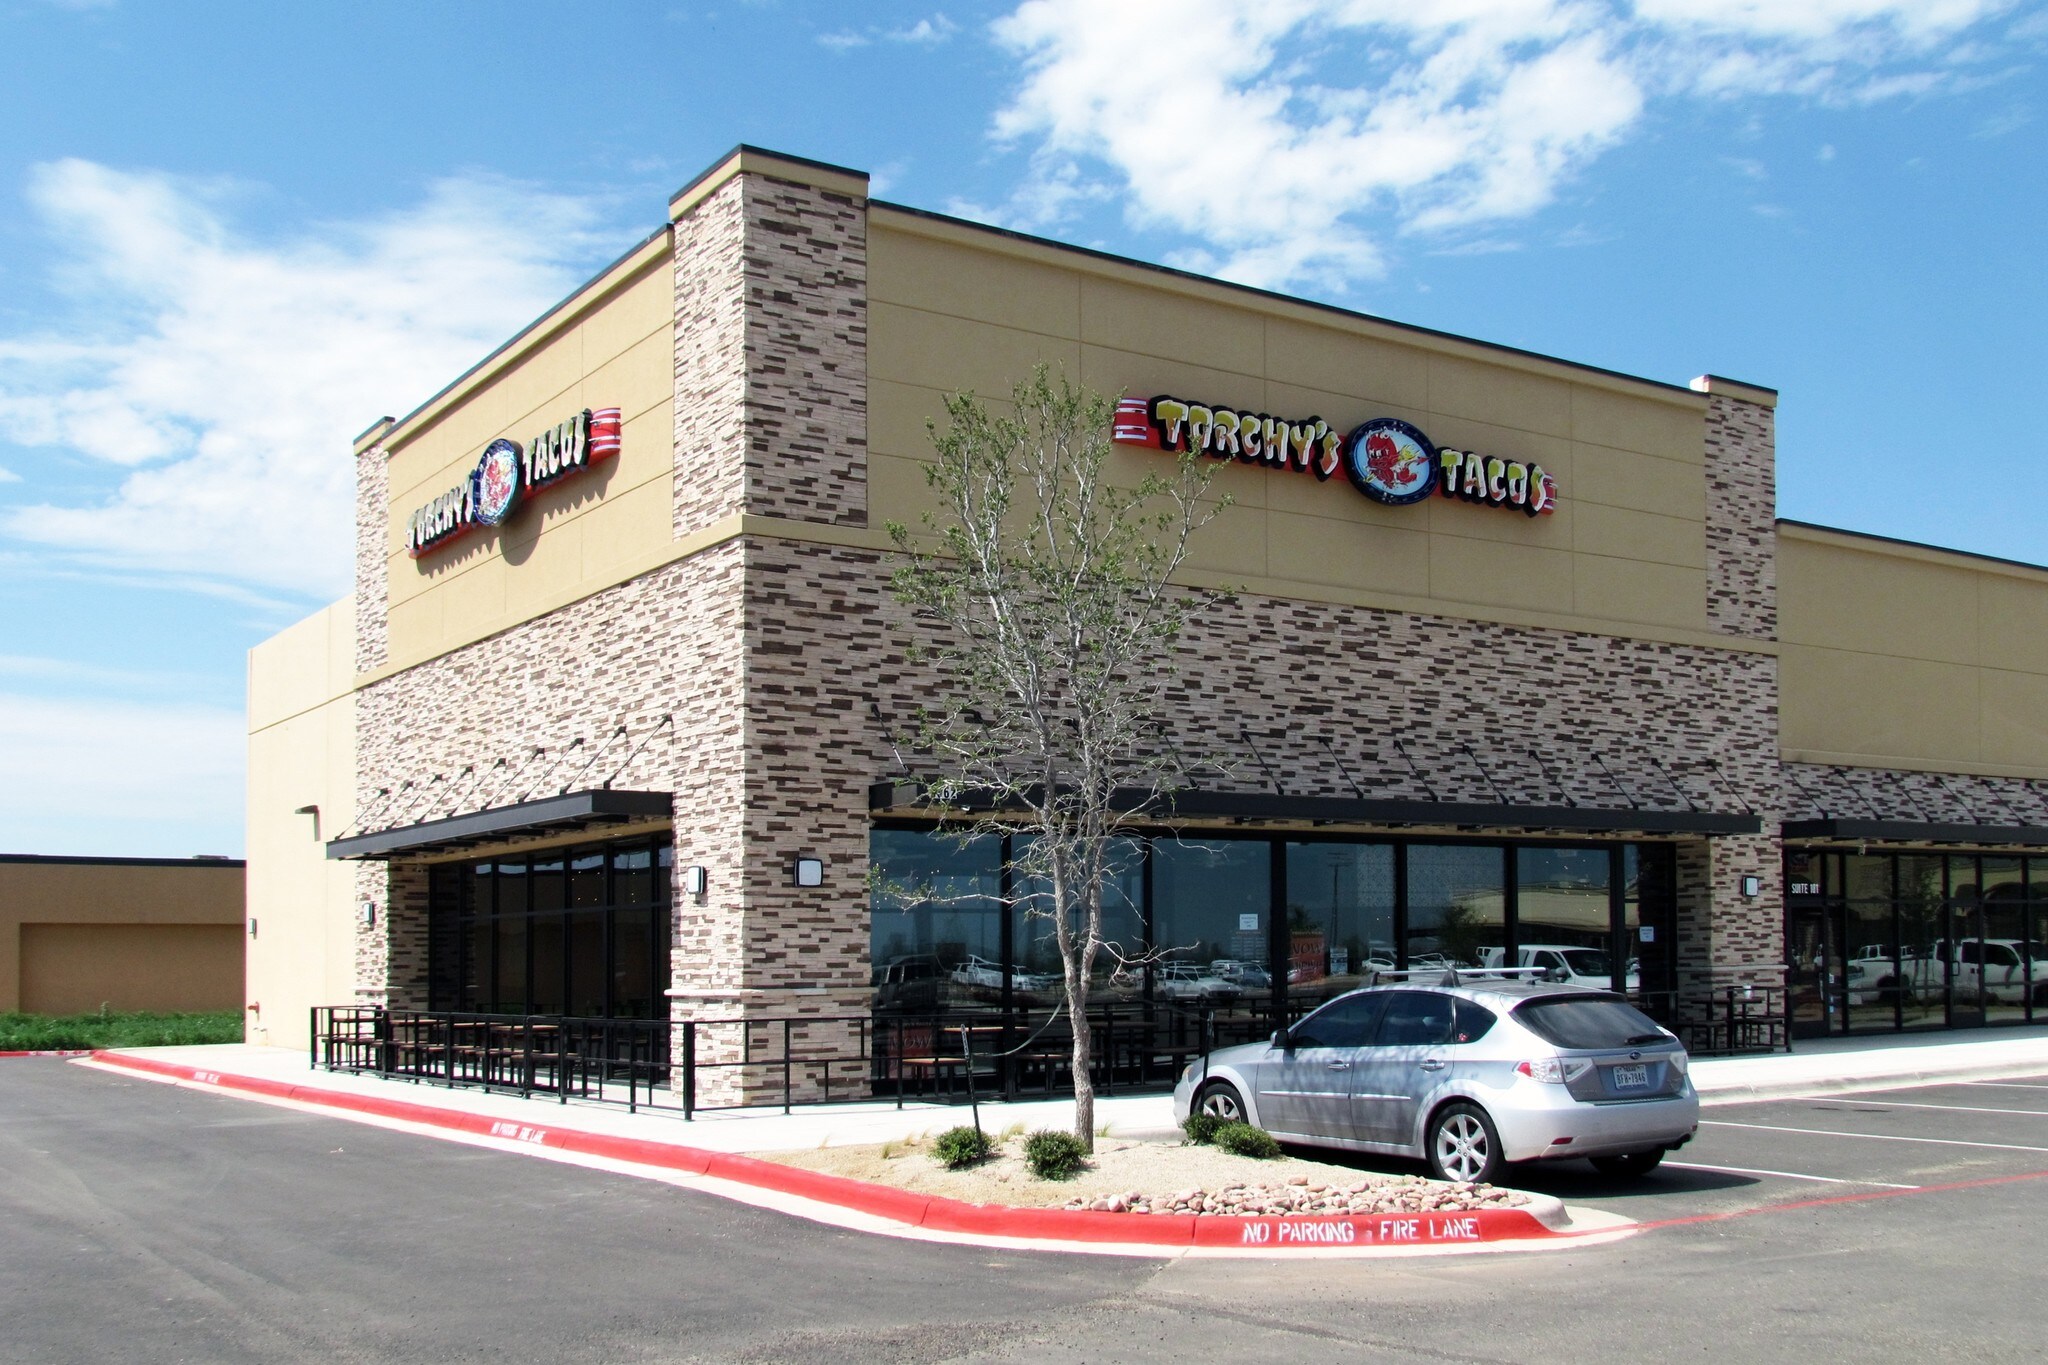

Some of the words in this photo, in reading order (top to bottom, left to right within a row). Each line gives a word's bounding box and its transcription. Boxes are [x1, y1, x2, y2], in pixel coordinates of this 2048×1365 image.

[1156, 399, 1342, 476] TORCHY'S
[1791, 883, 1808, 894] SUITE
[1243, 1222, 1270, 1243] NO
[1278, 1221, 1355, 1243] PARKING
[1381, 1219, 1422, 1241] FIRE
[1430, 1217, 1481, 1239] LANE
